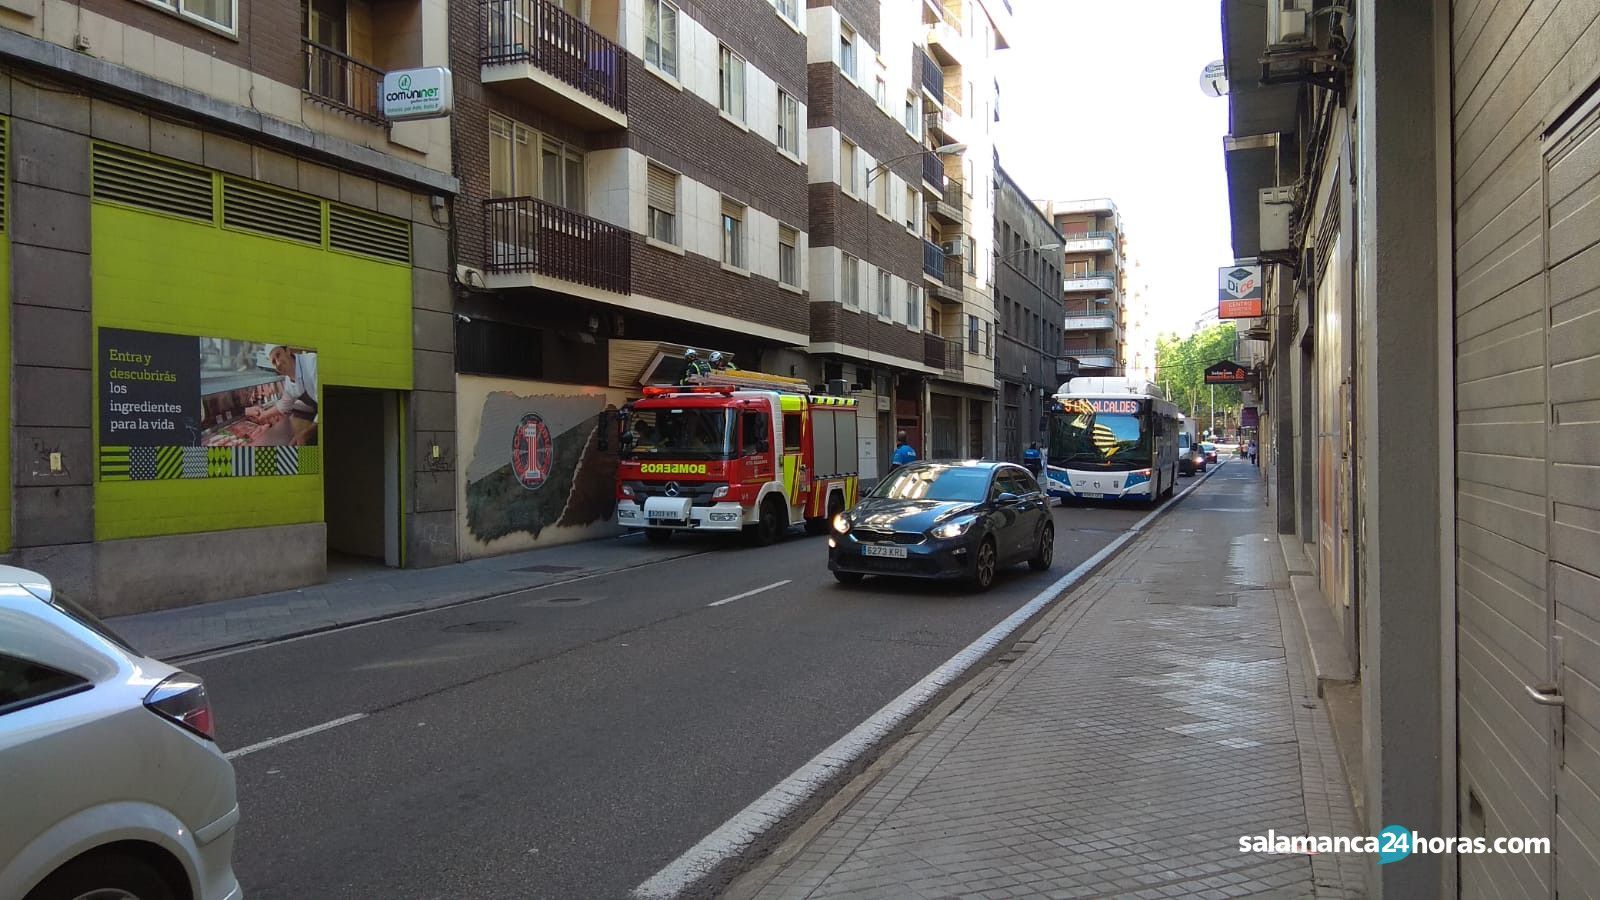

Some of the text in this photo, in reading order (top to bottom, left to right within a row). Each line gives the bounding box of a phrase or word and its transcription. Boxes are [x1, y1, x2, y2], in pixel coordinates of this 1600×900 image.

[109, 349, 151, 365] Entra y
[109, 367, 176, 381] descubrirás
[110, 382, 127, 393] los
[110, 399, 182, 415] ingredientes
[1093, 400, 1137, 413] ALCALDES
[110, 418, 175, 433] para la vida
